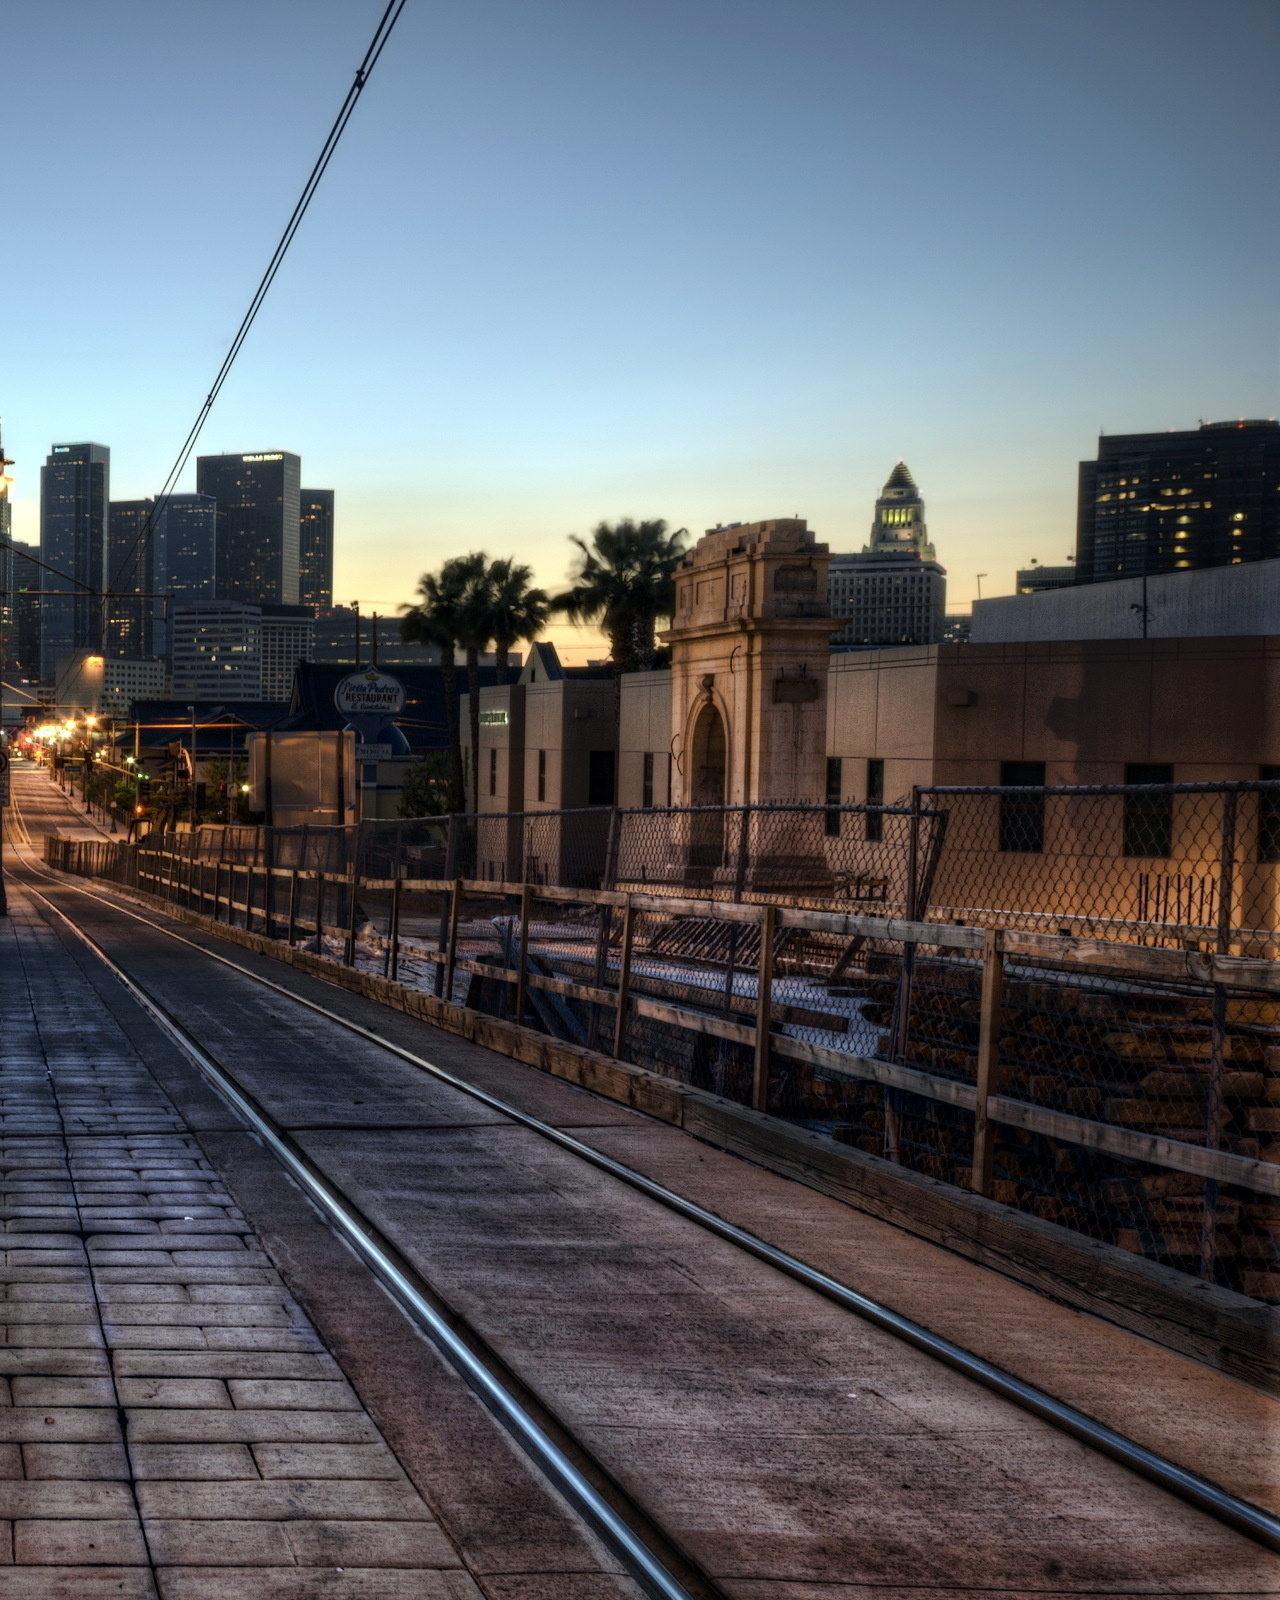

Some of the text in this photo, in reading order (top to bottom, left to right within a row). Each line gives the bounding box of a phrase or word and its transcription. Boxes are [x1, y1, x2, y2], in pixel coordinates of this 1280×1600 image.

[341, 682, 400, 694] Little Pedro's
[345, 692, 398, 703] RESTAURANT
